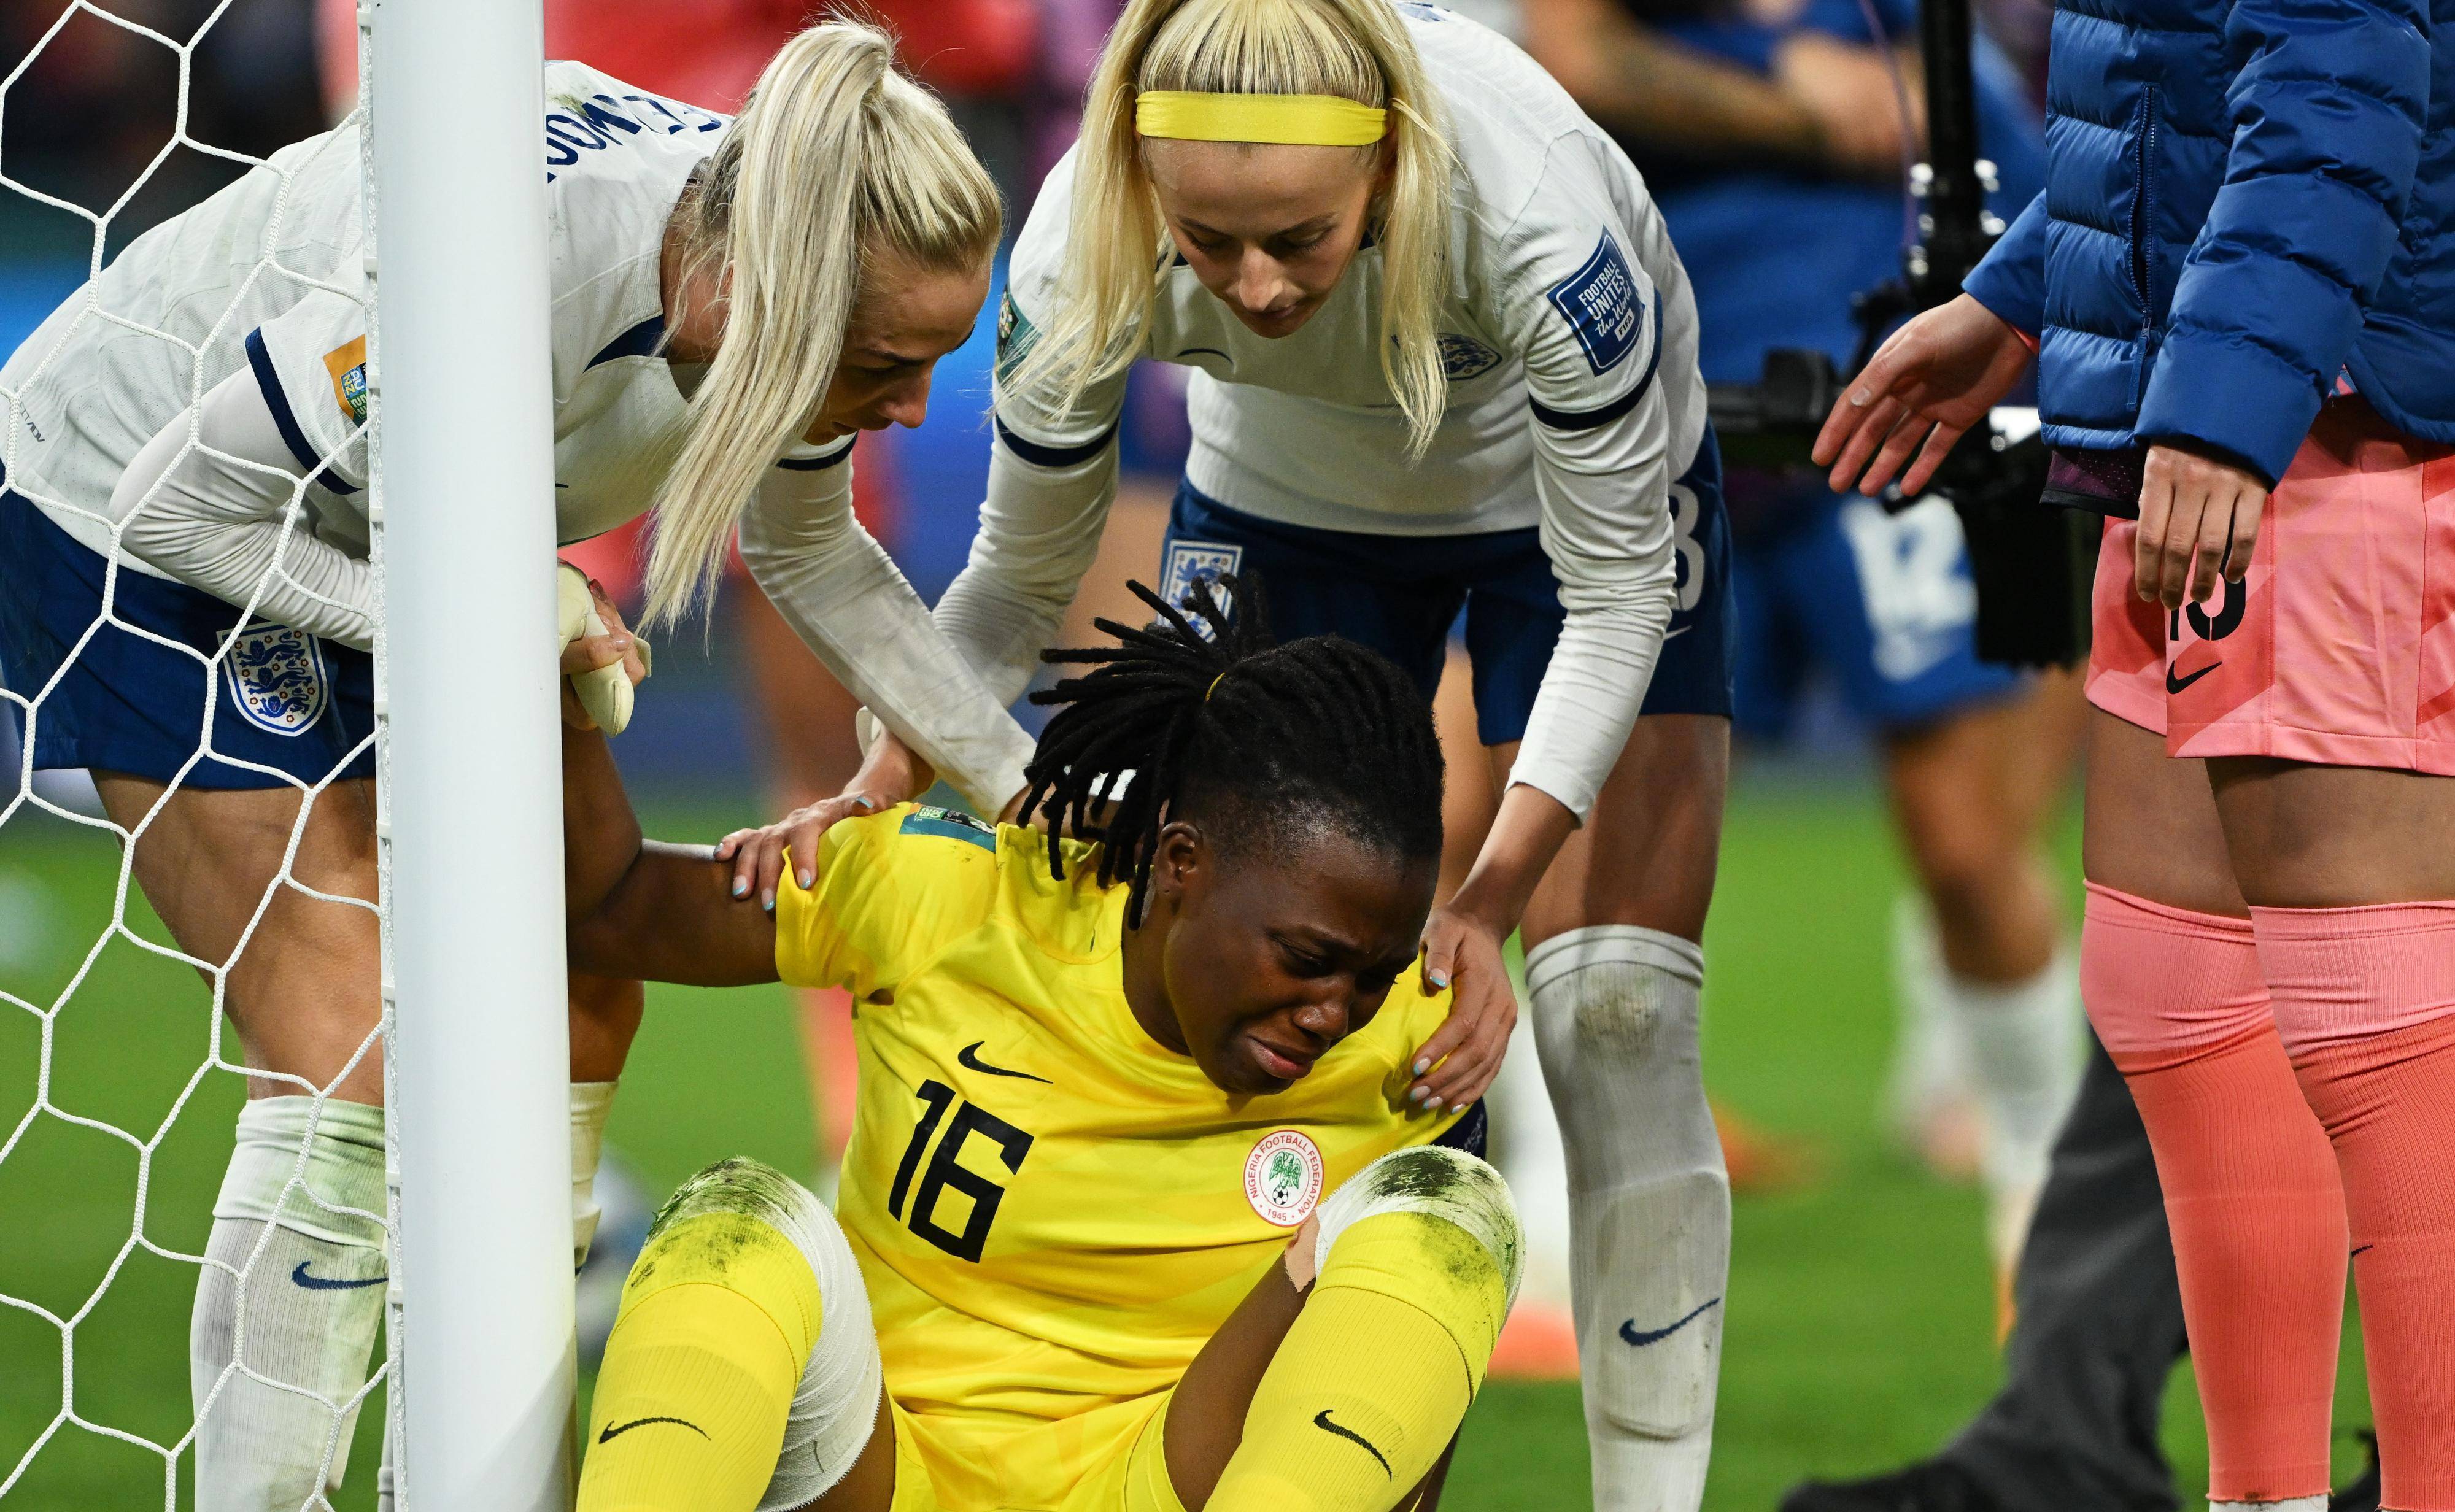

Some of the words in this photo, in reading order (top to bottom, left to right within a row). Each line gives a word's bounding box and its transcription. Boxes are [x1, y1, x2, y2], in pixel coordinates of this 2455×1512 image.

[1578, 258, 1617, 306] FOOTBALL
[1587, 268, 1625, 321] UNITES
[1595, 317, 1615, 337] the
[1612, 280, 1633, 320] World
[1618, 315, 1633, 336] FIFA
[888, 1079, 1035, 1263] 16
[1248, 1154, 1262, 1198] NIGERIA
[1259, 1135, 1308, 1154] FOOTBALL
[1298, 1151, 1320, 1216] FEDERATION
[1267, 1208, 1287, 1221] 1945
